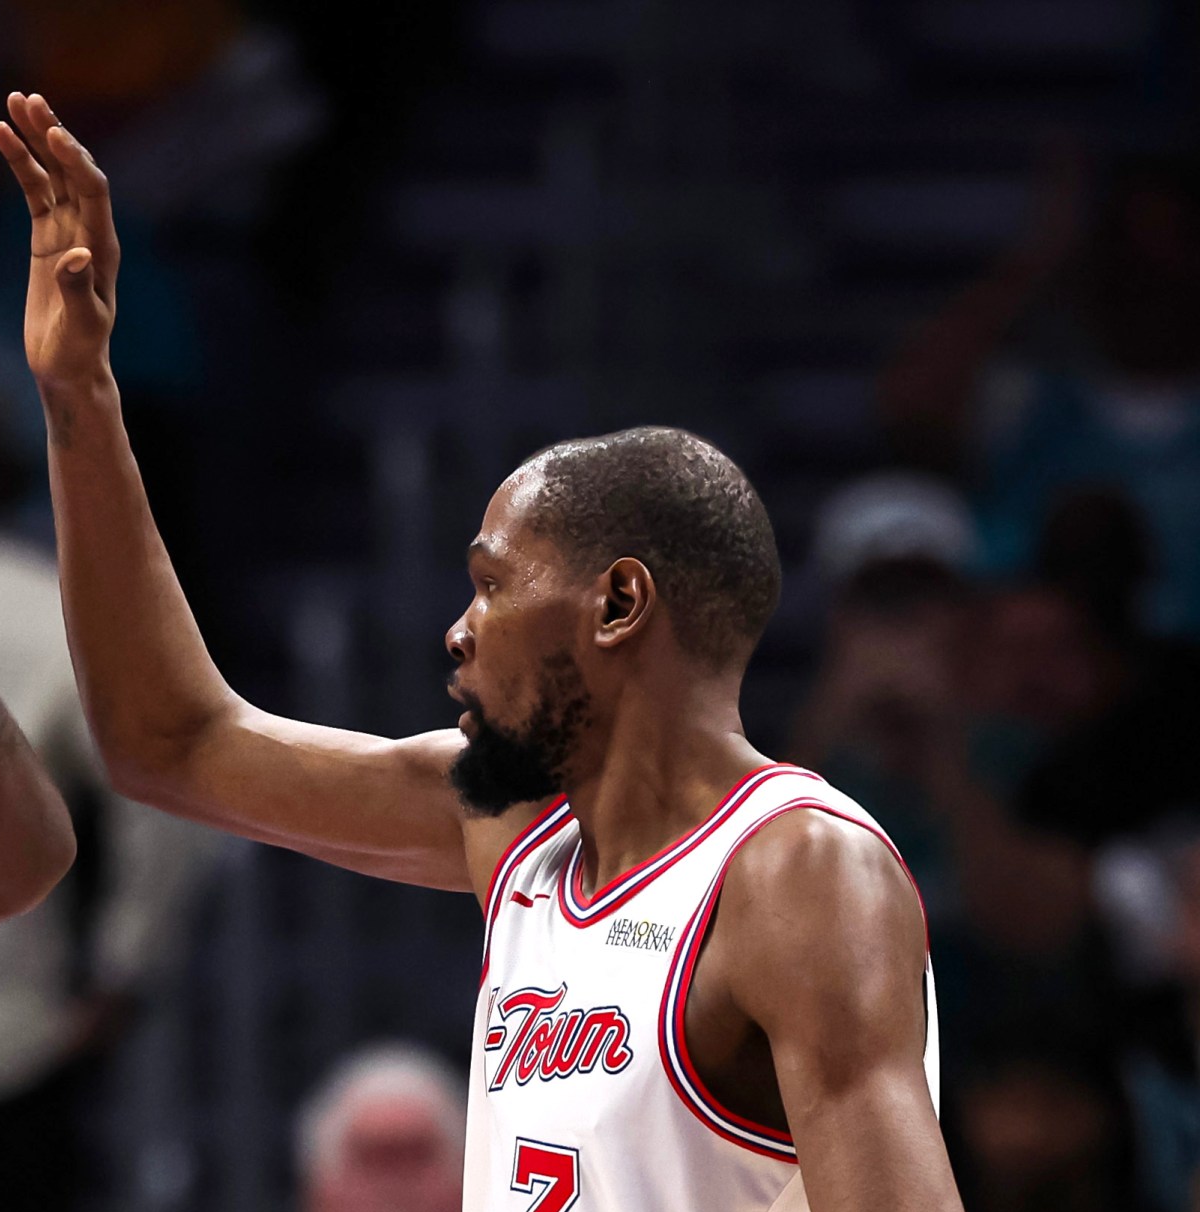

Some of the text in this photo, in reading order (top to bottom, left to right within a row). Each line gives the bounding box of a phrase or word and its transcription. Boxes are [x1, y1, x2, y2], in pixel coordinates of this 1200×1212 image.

[605, 930, 674, 952] HERMANN
[610, 918, 676, 941] MEMORIAL
[485, 981, 633, 1092] -Town
